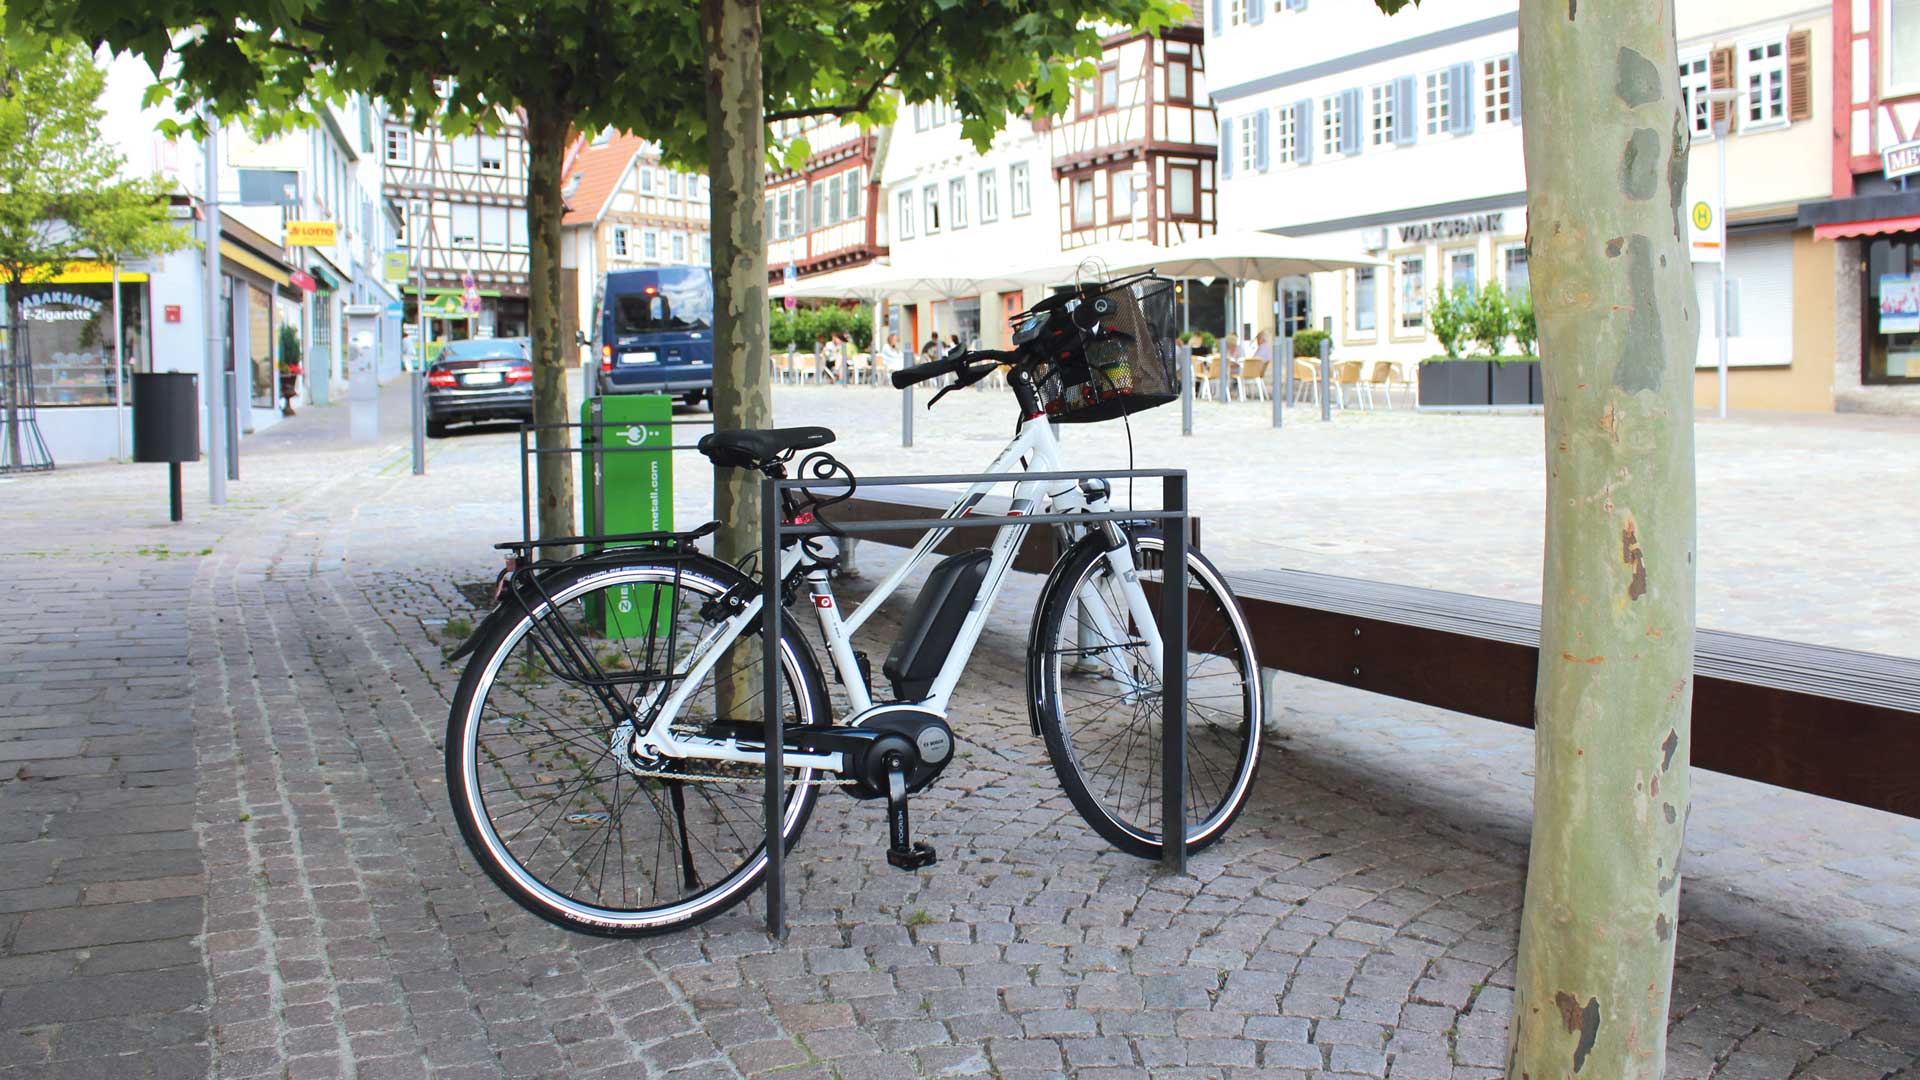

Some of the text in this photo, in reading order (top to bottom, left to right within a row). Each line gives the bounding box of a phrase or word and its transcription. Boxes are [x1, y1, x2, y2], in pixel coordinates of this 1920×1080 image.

[303, 227, 334, 237] LOTTO
[1398, 213, 1502, 243] VOLKSBANK
[23, 308, 91, 322] E-Zigarette
